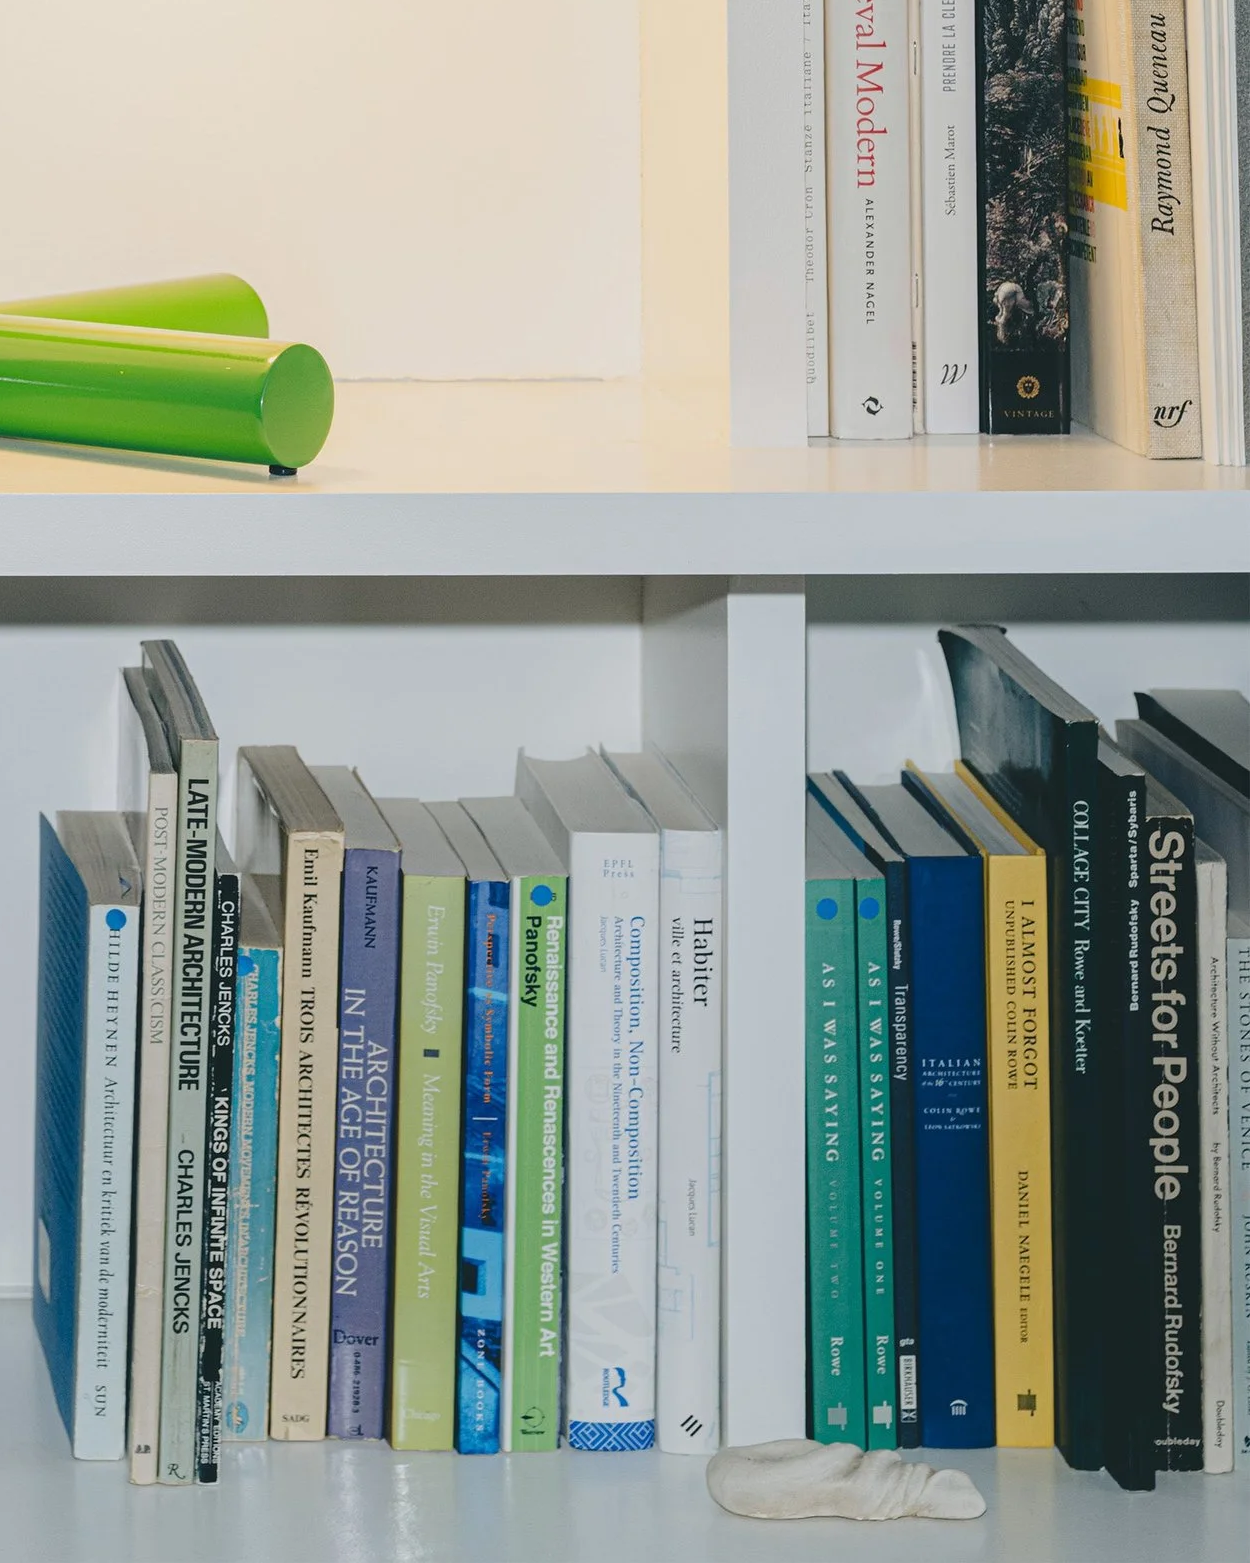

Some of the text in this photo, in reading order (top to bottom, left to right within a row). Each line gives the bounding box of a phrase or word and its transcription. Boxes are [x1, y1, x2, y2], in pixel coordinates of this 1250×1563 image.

[1147, 13, 1175, 113] Queneau
[857, 60, 887, 188] Modern
[1147, 126, 1175, 235] Raymond
[866, 199, 874, 275] ALEXANDER
[866, 283, 875, 324] NAGEL
[364, 867, 378, 948] KAUFMANN
[521, 916, 541, 1007] Panofsky
[1022, 917, 1036, 998] ALMOST
[1073, 801, 1091, 1074] COLLAGE CITY Rowe and Koetter
[694, 920, 713, 1006] Habiter
[173, 779, 209, 1334] LATE-MODERN ARCHITECTURE CHARLES JENCKS
[625, 916, 644, 1199] Composition, Non-Composition
[892, 984, 908, 1080] Transparency
[1023, 1009, 1037, 1089] FORGOT
[292, 849, 318, 1379] Emil Kaufmann TROIS ARCHITECTES RÉVOLUTIONNAIRES
[336, 989, 365, 1296] IN THE AGE OF REASON
[362, 1040, 388, 1247] ARCHITECTURE
[540, 916, 563, 1356] Renaissance and Renascences in Western Art
[1149, 830, 1188, 1413] Streets for People Bernard Rudofsky
